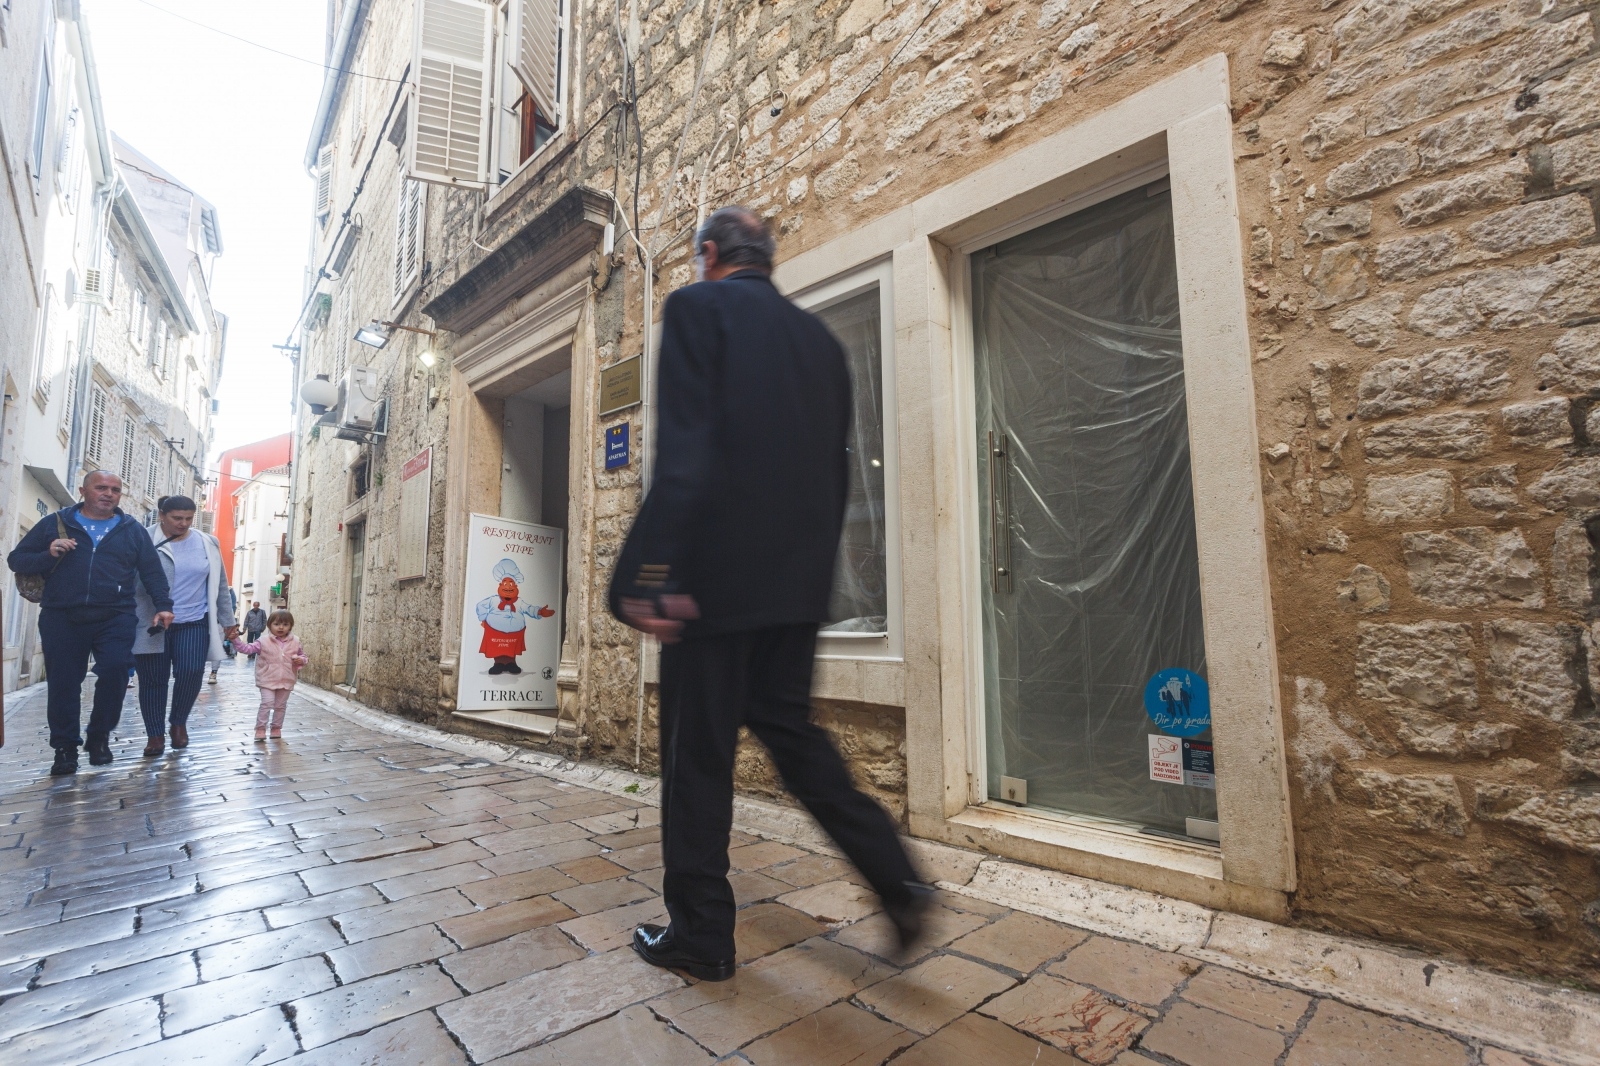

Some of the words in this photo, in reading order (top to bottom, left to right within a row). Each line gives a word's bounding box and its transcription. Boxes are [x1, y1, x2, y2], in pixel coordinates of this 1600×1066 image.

[608, 452, 626, 460] APARTMAN
[482, 526, 554, 545] RESTAURANT
[503, 543, 535, 556] STIPE
[480, 690, 543, 702] TERRACE
[1172, 717, 1182, 728] po
[1154, 772, 1180, 780] NADZOROM
